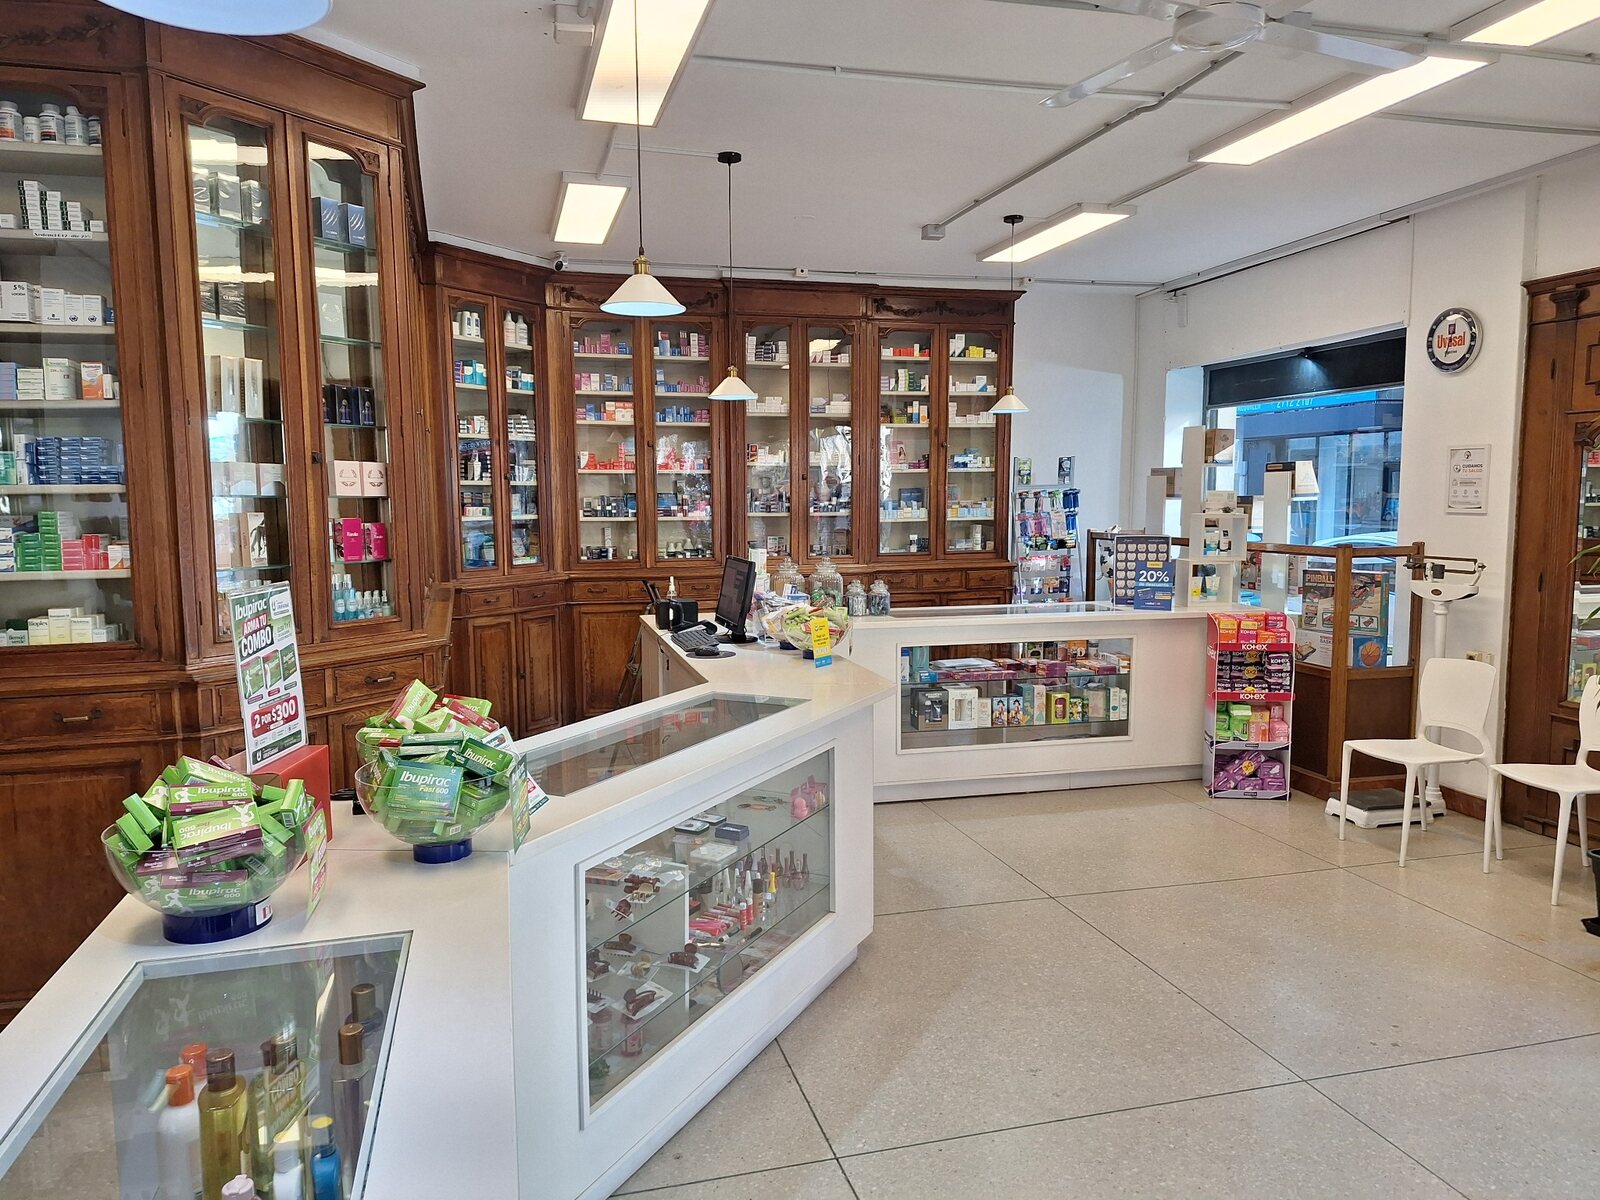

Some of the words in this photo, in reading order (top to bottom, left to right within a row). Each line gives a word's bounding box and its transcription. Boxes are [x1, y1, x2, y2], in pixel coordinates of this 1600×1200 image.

[1437, 331, 1466, 349] Uvasal
[1138, 570, 1170, 582] 20%
[1305, 574, 1334, 583] PINBALL
[235, 599, 268, 620] Ibupirac
[244, 616, 260, 636] ARMA
[259, 614, 267, 627] TU
[241, 626, 271, 657] COMBO
[254, 714, 260, 729] 2
[261, 714, 271, 724] POR
[272, 699, 296, 722] $300
[463, 748, 497, 769] Ibupirac
[400, 771, 452, 787] Ibupirac
[198, 786, 247, 795] Ibupirac
[420, 784, 435, 793] Fast
[179, 825, 196, 833] 600
[180, 822, 232, 840] Ibupirac
[189, 887, 240, 896] Ibupirac
